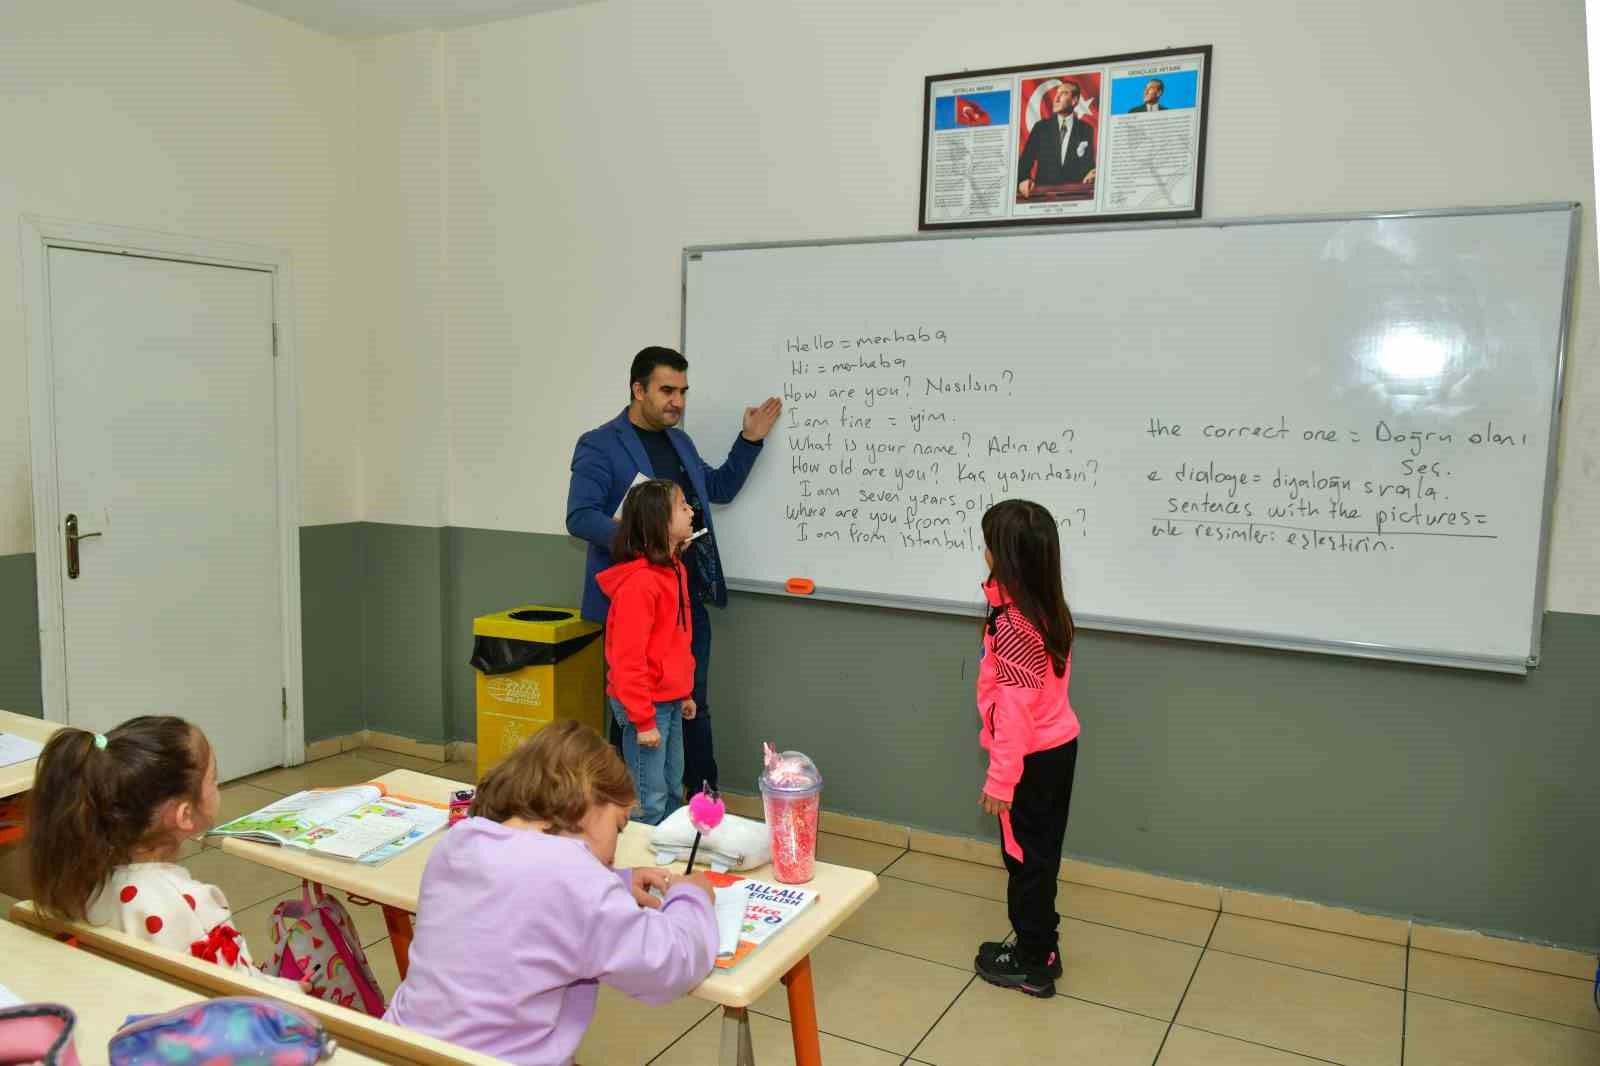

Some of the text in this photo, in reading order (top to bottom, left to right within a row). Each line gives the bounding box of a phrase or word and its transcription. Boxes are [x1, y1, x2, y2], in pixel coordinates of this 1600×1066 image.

[787, 333, 835, 352] Hello
[856, 327, 947, 348] merhaba
[791, 359, 809, 376] Hi
[783, 383, 817, 402] How
[829, 388, 855, 399] are
[865, 375, 911, 407] you?
[787, 407, 799, 429] I
[804, 417, 830, 429] am
[840, 406, 872, 429] fine
[1147, 417, 1183, 438] the
[1203, 416, 1290, 439] correct
[1303, 430, 1337, 442] one
[788, 432, 833, 451] What
[844, 438, 857, 450] is
[866, 443, 906, 464] your
[913, 432, 972, 458] name?
[792, 455, 820, 474] How
[829, 459, 852, 475] old
[862, 466, 885, 478] are
[894, 463, 939, 490] you?
[801, 481, 812, 497] I
[816, 486, 840, 498] am
[859, 488, 900, 503] seven
[909, 494, 956, 516] years
[1268, 498, 1319, 518] with
[1328, 499, 1360, 519] the
[835, 507, 859, 519] are
[869, 510, 897, 530] you
[796, 523, 809, 543] I
[816, 530, 840, 541] am
[849, 523, 886, 543] from
